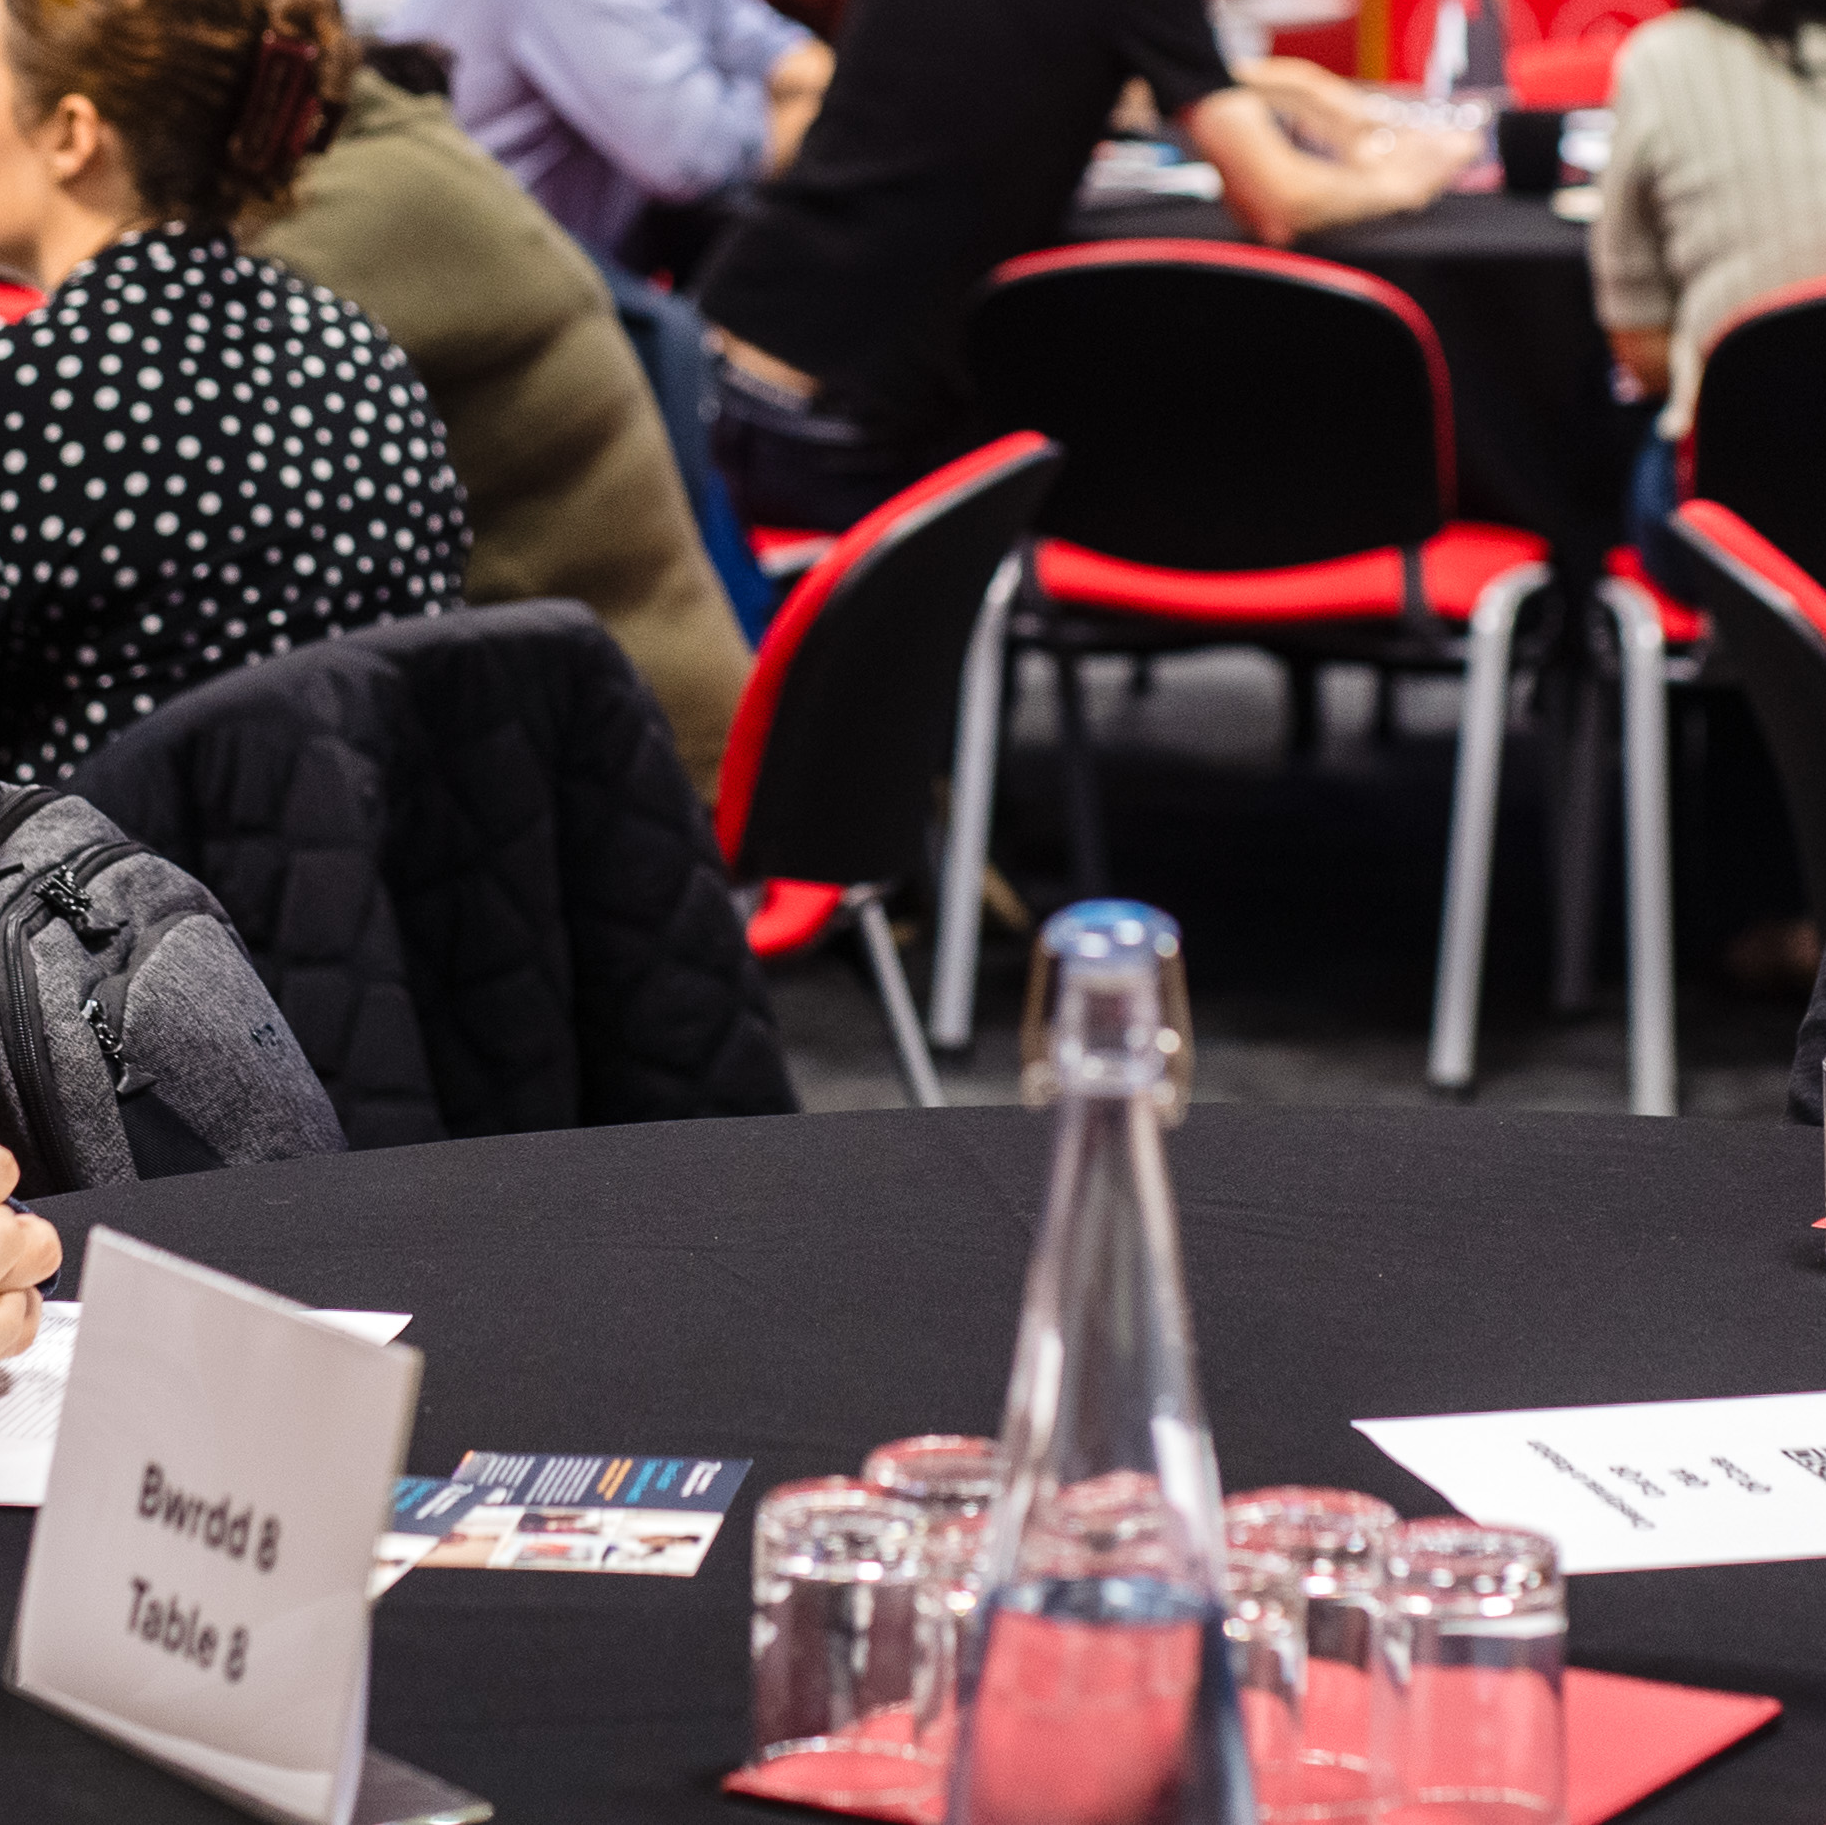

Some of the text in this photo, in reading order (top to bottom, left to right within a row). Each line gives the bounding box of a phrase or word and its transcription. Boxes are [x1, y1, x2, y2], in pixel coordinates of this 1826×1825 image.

[138, 1460, 282, 1573] Bwrdd 8
[129, 1575, 250, 1685] Table 8
